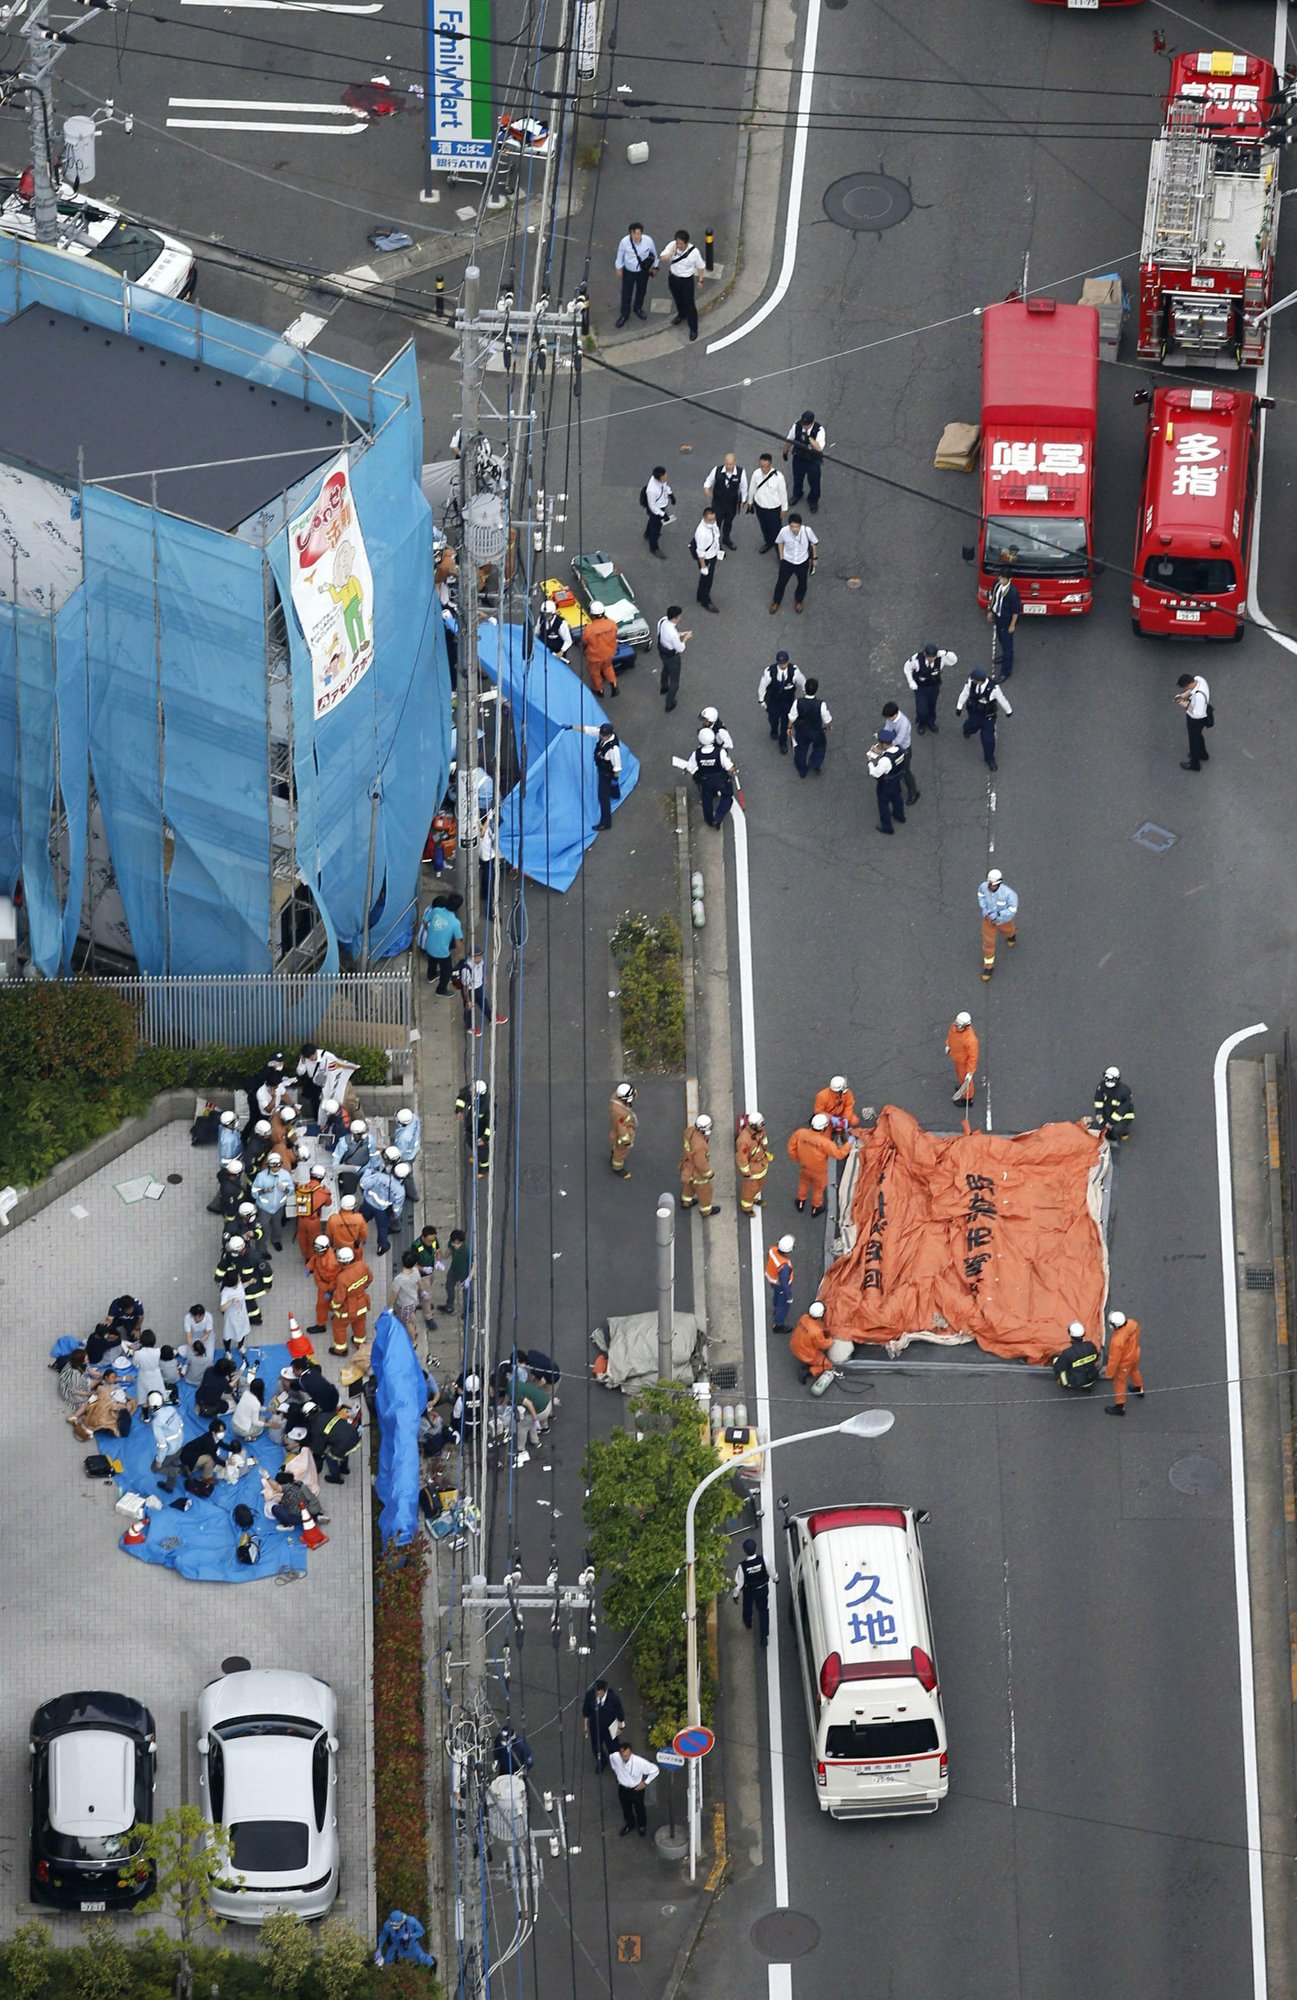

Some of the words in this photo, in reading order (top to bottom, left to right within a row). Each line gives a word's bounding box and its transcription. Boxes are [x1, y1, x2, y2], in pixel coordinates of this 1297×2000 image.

[436, 10, 465, 129] FamilyMart
[436, 157, 488, 170] 銀行ATM
[437, 141, 452, 154] 酒
[456, 143, 486, 155] たばこ
[990, 441, 1086, 477] 宮前
[1171, 432, 1221, 497] 多指
[844, 1571, 899, 1645] 久地
